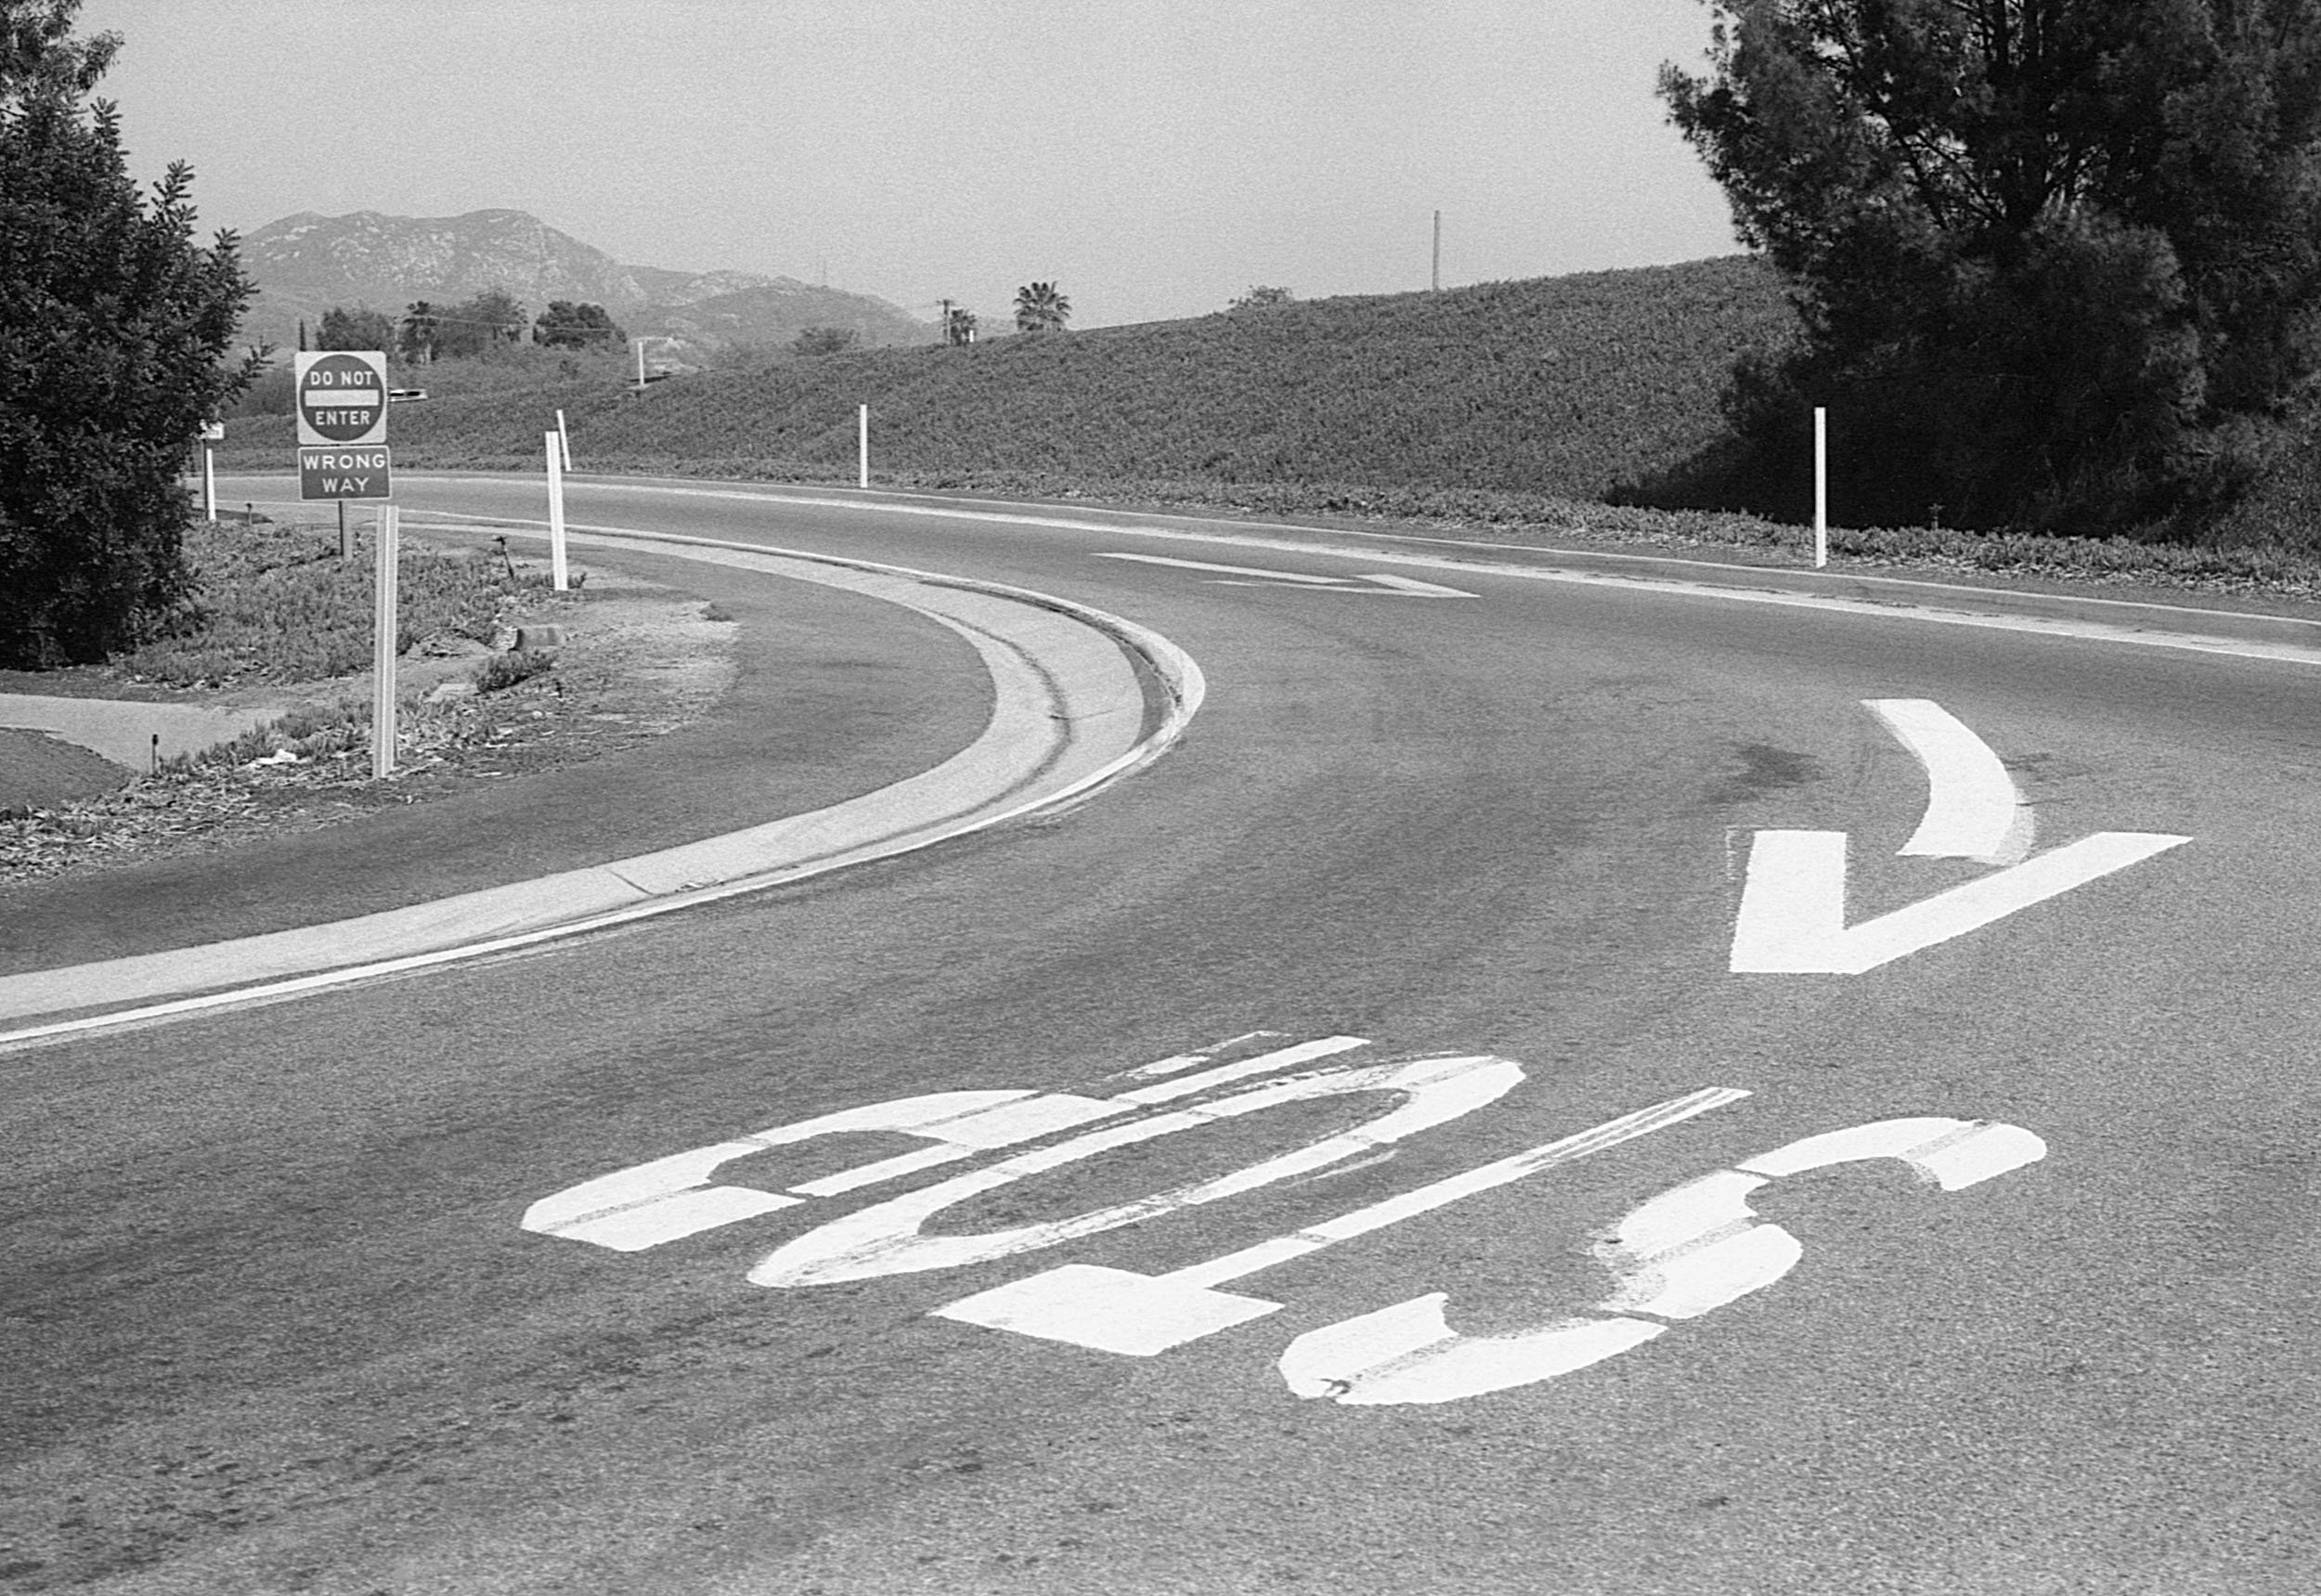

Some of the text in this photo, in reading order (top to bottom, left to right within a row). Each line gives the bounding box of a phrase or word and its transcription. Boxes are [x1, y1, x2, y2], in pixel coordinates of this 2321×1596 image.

[310, 370, 374, 385] DO NOT
[315, 410, 370, 425] ENTER
[303, 453, 385, 470] WRONG
[322, 477, 370, 493] WAY
[521, 1031, 2048, 1407] STOP
